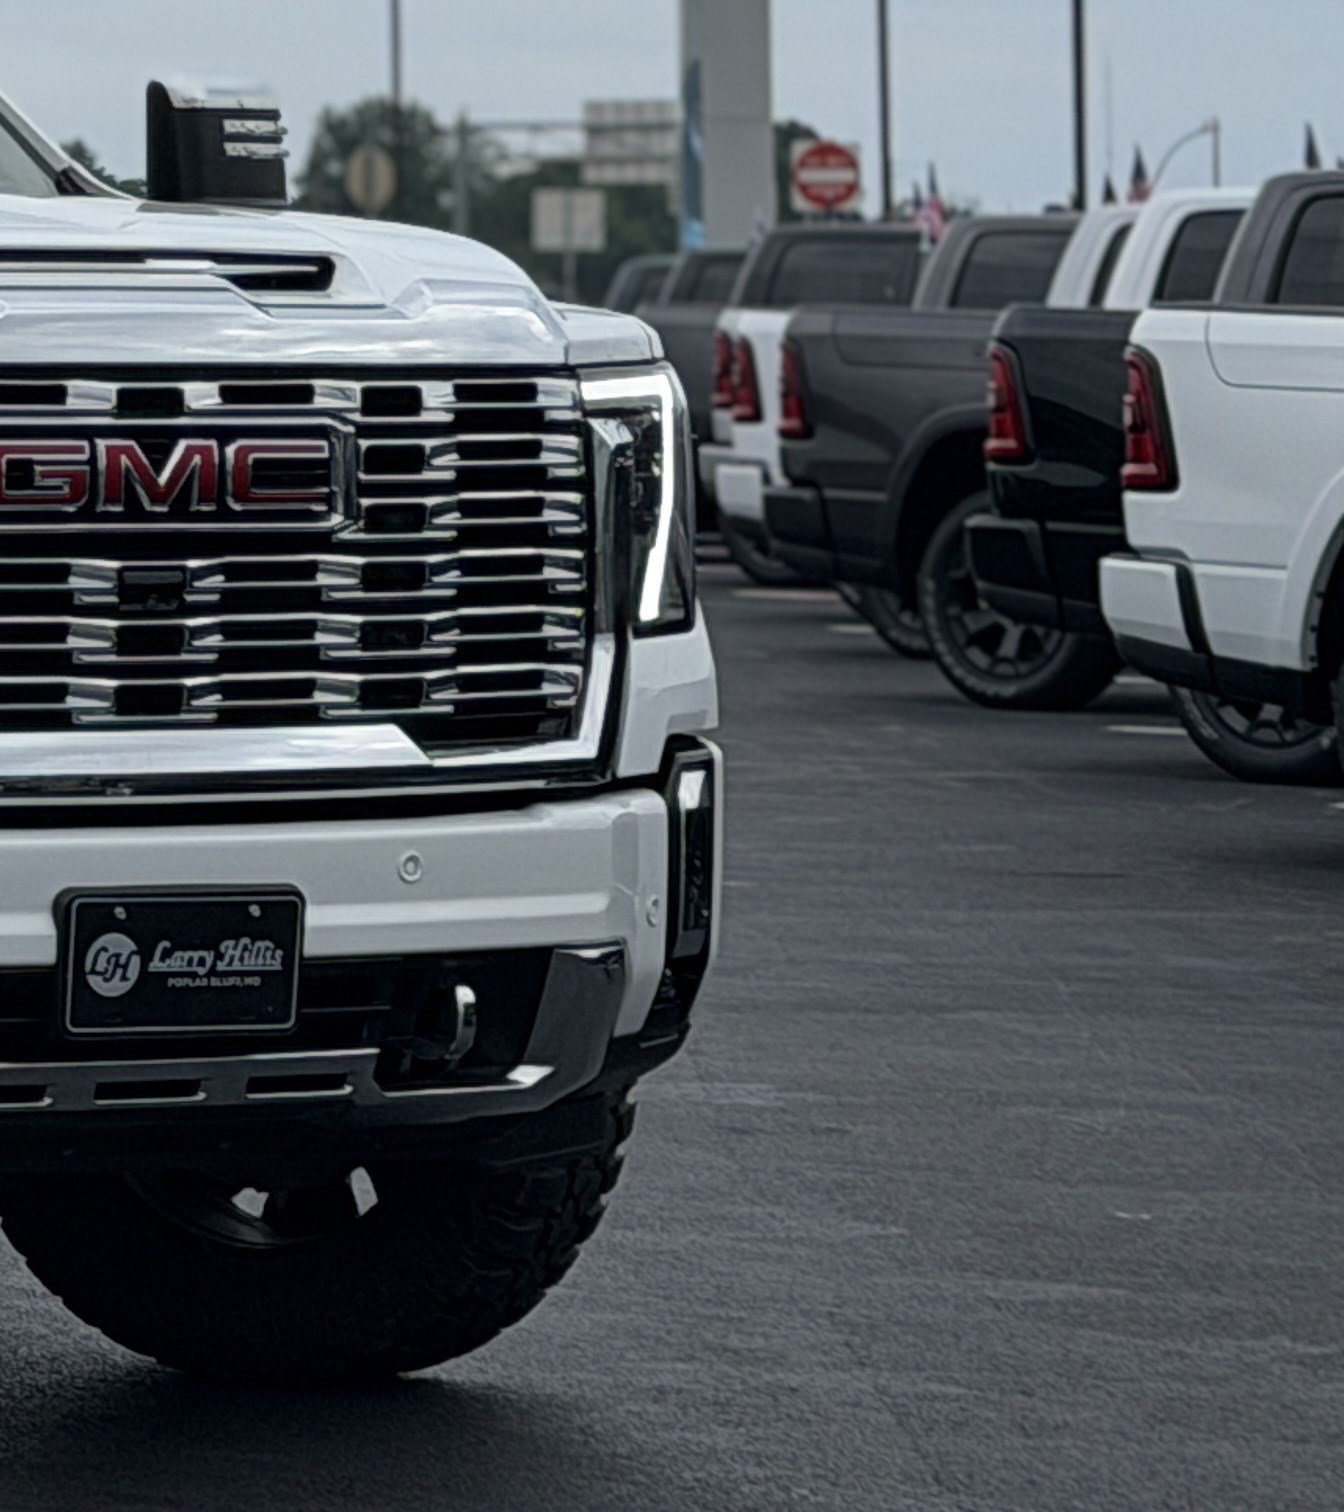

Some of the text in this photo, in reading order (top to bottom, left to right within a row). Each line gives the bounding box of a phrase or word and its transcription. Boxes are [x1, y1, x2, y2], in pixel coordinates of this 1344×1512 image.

[148, 937, 284, 976] Larry Hillis
[167, 976, 208, 988] POPLAR
